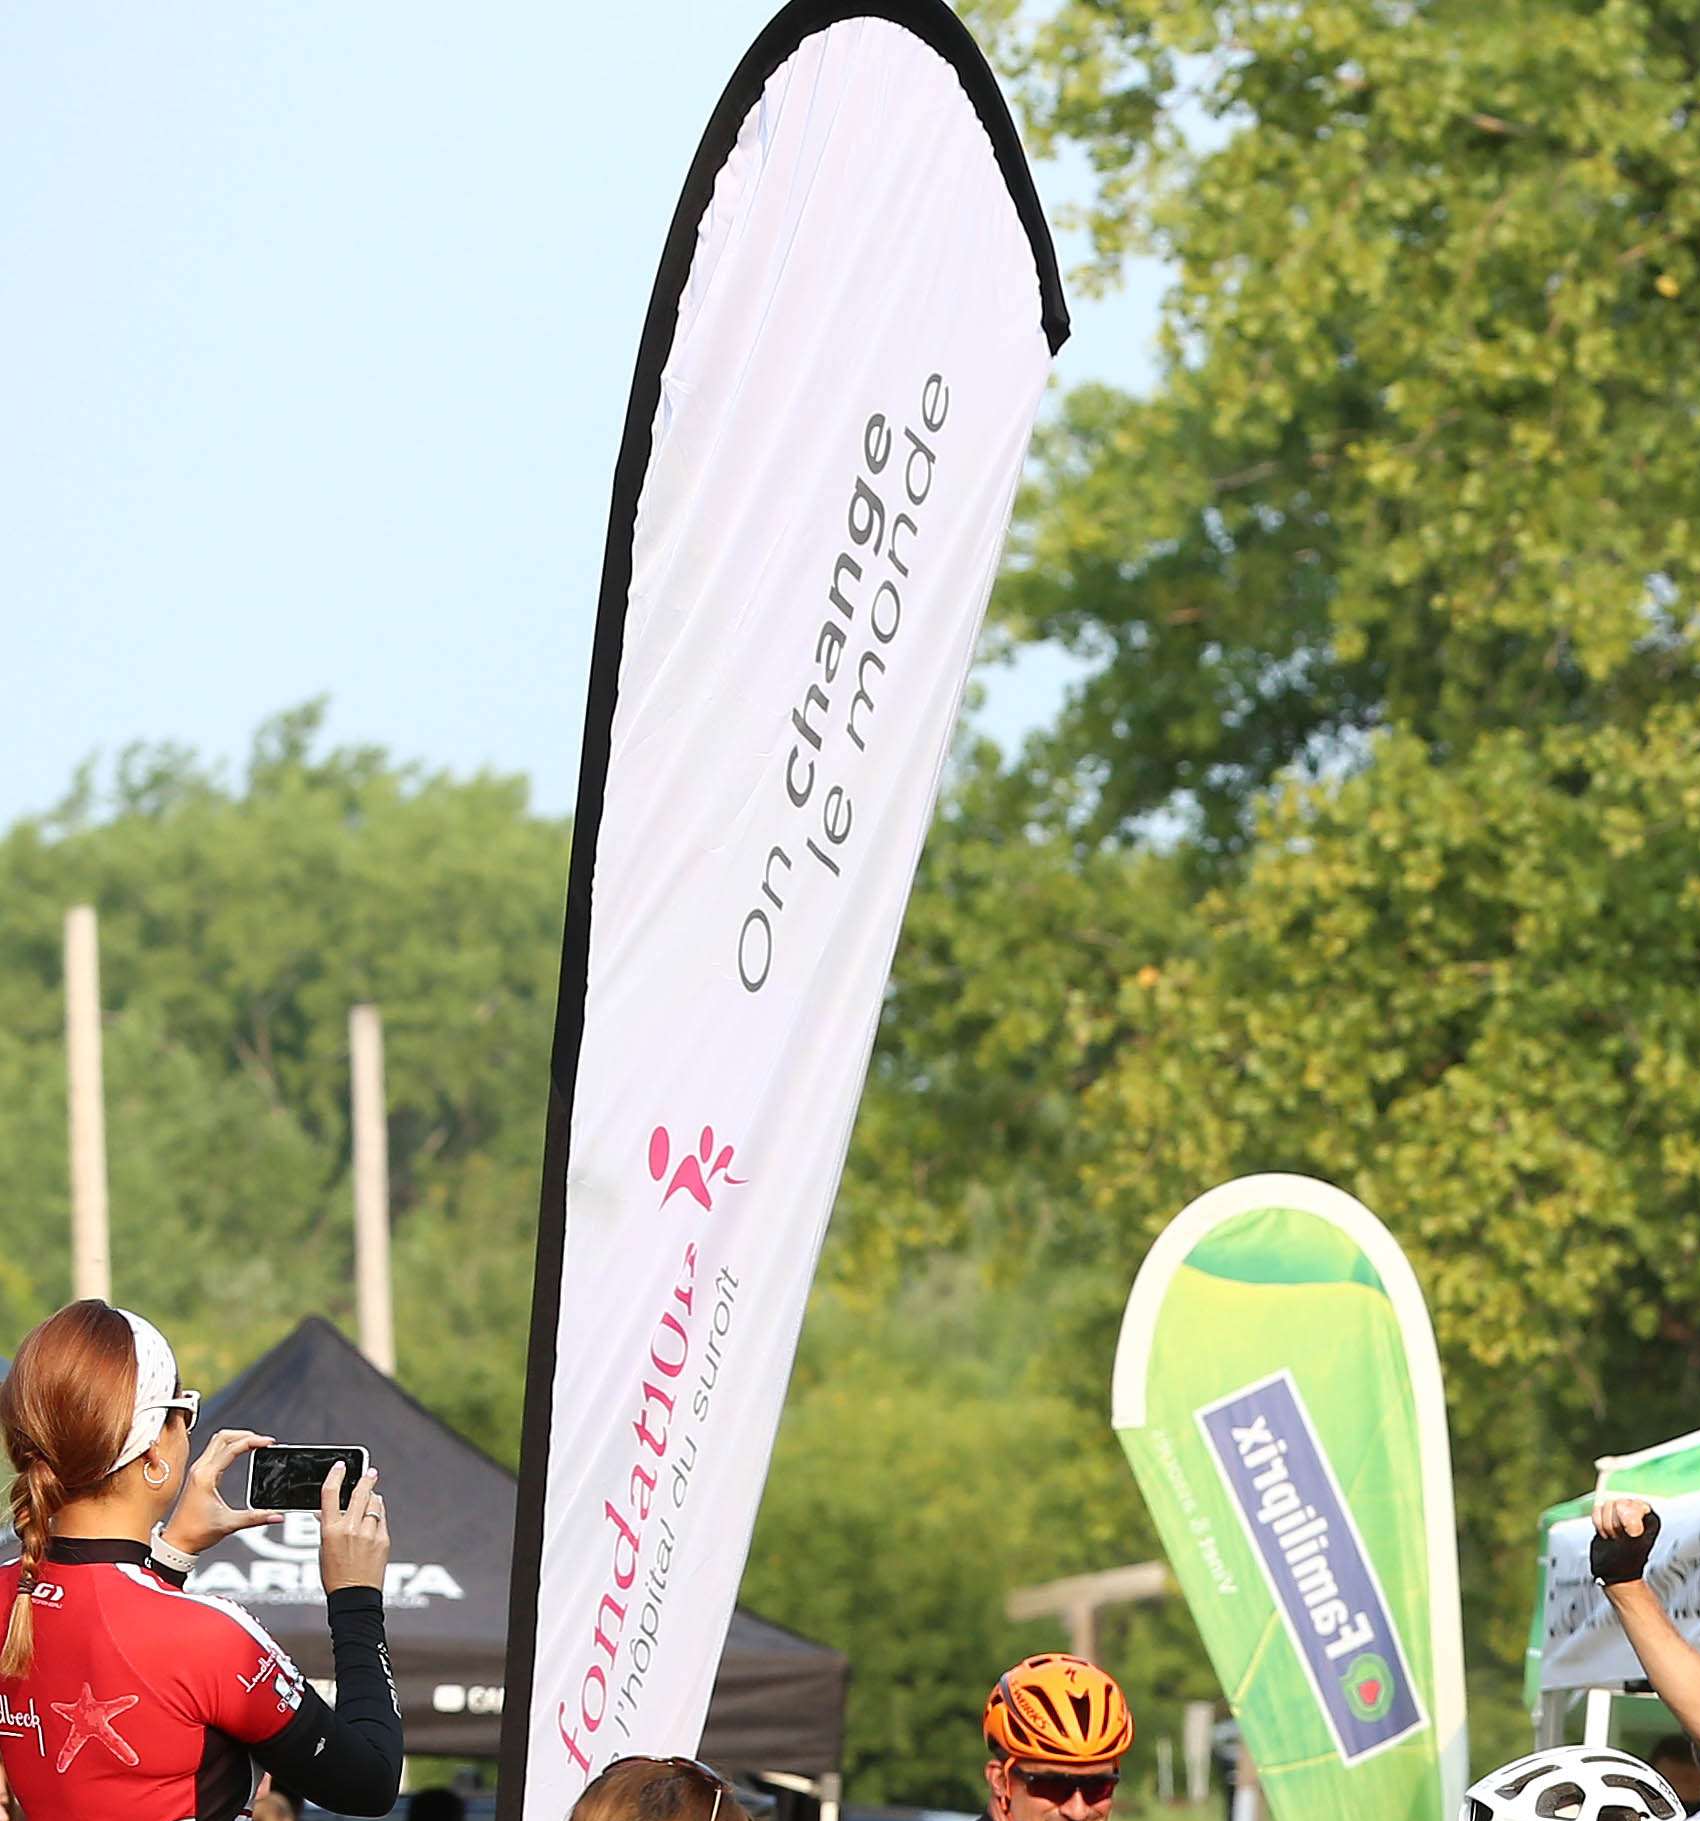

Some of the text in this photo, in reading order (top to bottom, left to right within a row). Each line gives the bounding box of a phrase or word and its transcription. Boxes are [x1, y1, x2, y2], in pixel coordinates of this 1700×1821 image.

[738, 412, 892, 993] On change
[807, 373, 950, 877] le monde
[670, 1429, 698, 1509] du
[690, 1264, 742, 1419] suroît
